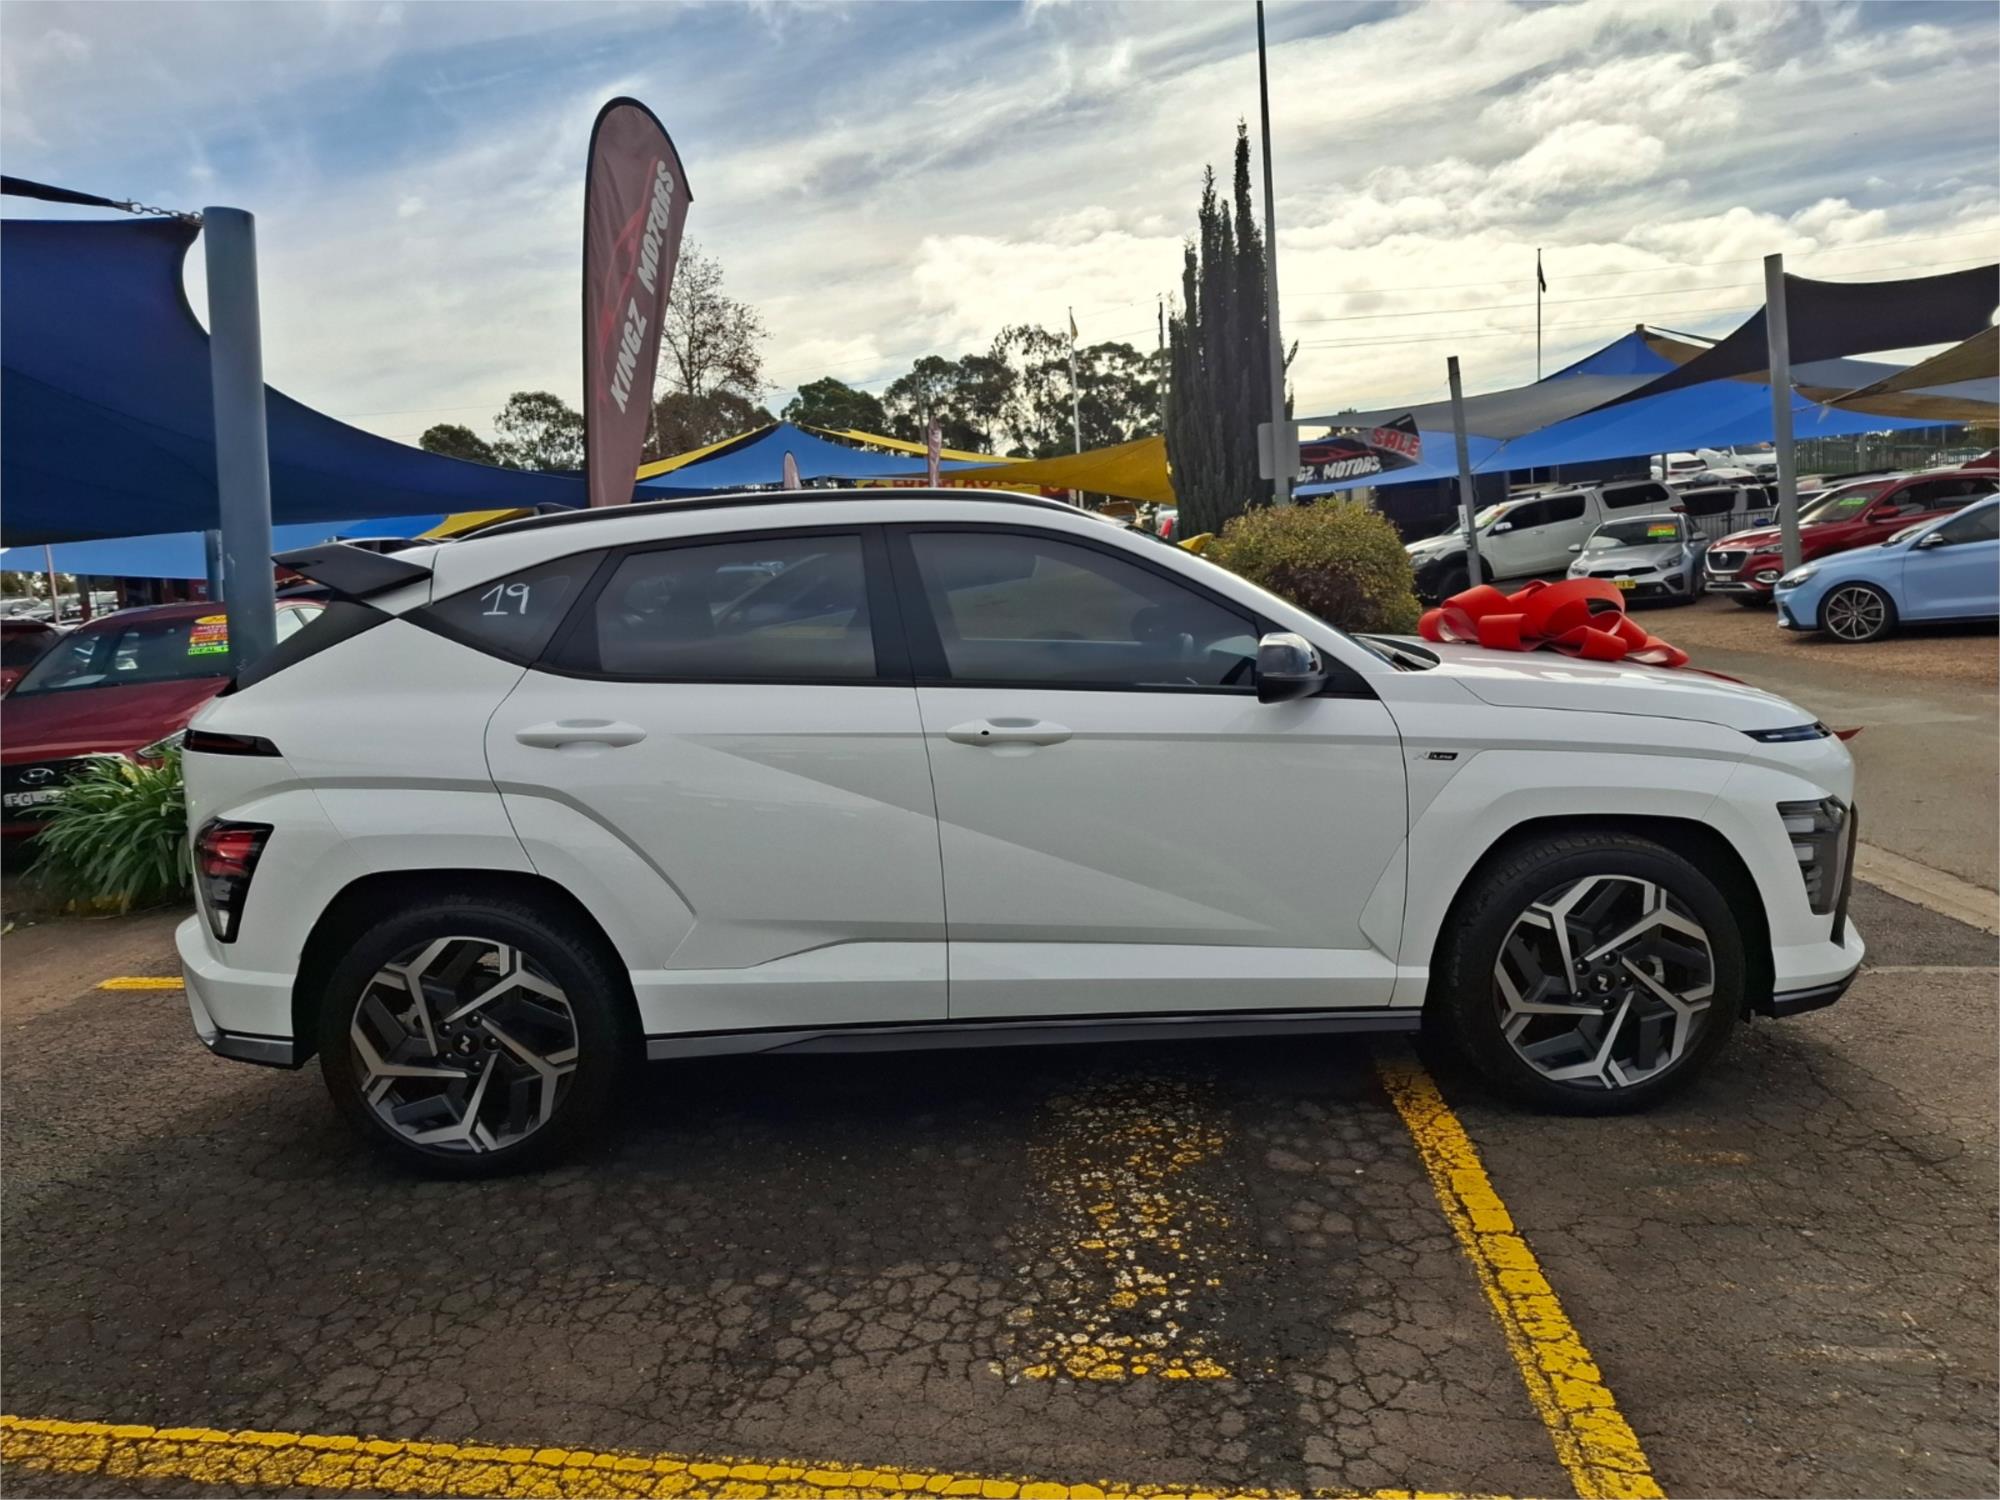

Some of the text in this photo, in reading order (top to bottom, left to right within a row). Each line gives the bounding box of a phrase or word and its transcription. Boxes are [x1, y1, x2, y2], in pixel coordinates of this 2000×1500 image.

[610, 160, 674, 414] KINGZ MOTORS
[1373, 427, 1420, 458] SALE
[1323, 456, 1381, 480] MOTORS
[480, 583, 530, 615] 19
